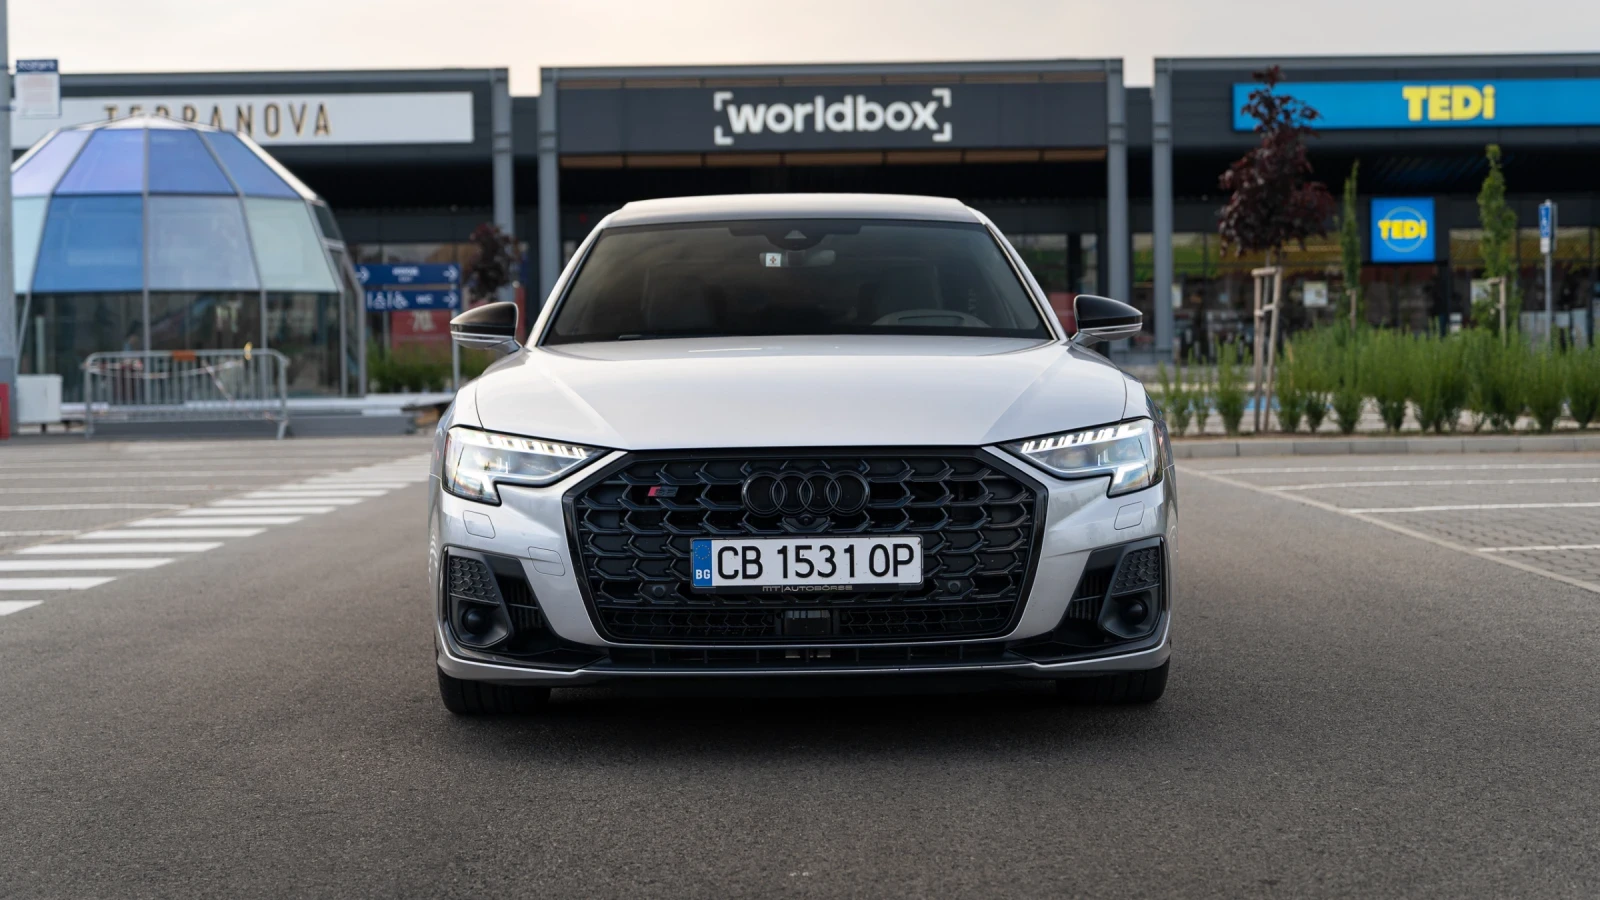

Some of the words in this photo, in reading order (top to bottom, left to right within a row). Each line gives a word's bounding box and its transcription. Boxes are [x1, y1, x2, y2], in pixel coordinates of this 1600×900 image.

[726, 94, 939, 134] worldbox
[1402, 84, 1495, 121] TEDi
[1378, 218, 1427, 241] TEDi
[695, 569, 711, 580] BG
[717, 545, 763, 580] CB
[777, 544, 855, 579] 1531
